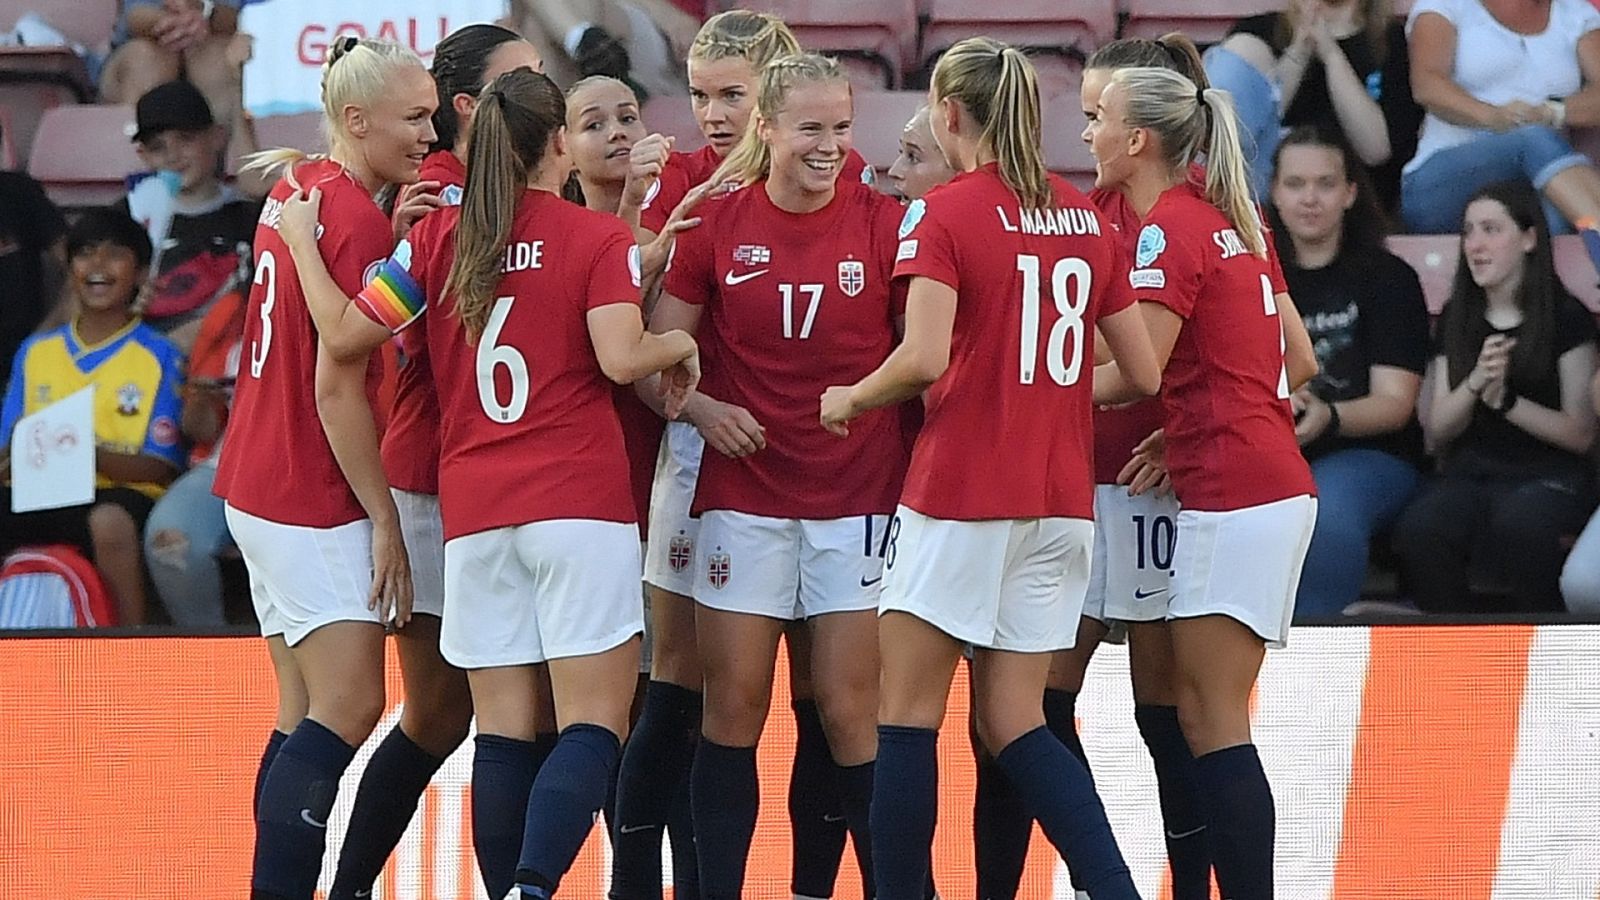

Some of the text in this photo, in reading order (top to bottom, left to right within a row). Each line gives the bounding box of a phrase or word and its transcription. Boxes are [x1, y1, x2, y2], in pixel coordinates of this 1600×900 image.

[1018, 206, 1101, 237] MAANUM
[501, 240, 544, 273] LDE
[251, 250, 276, 378] 3
[778, 283, 825, 339] 17
[1017, 254, 1092, 386] 18
[476, 296, 529, 423] 6
[1132, 514, 1174, 570] 10
